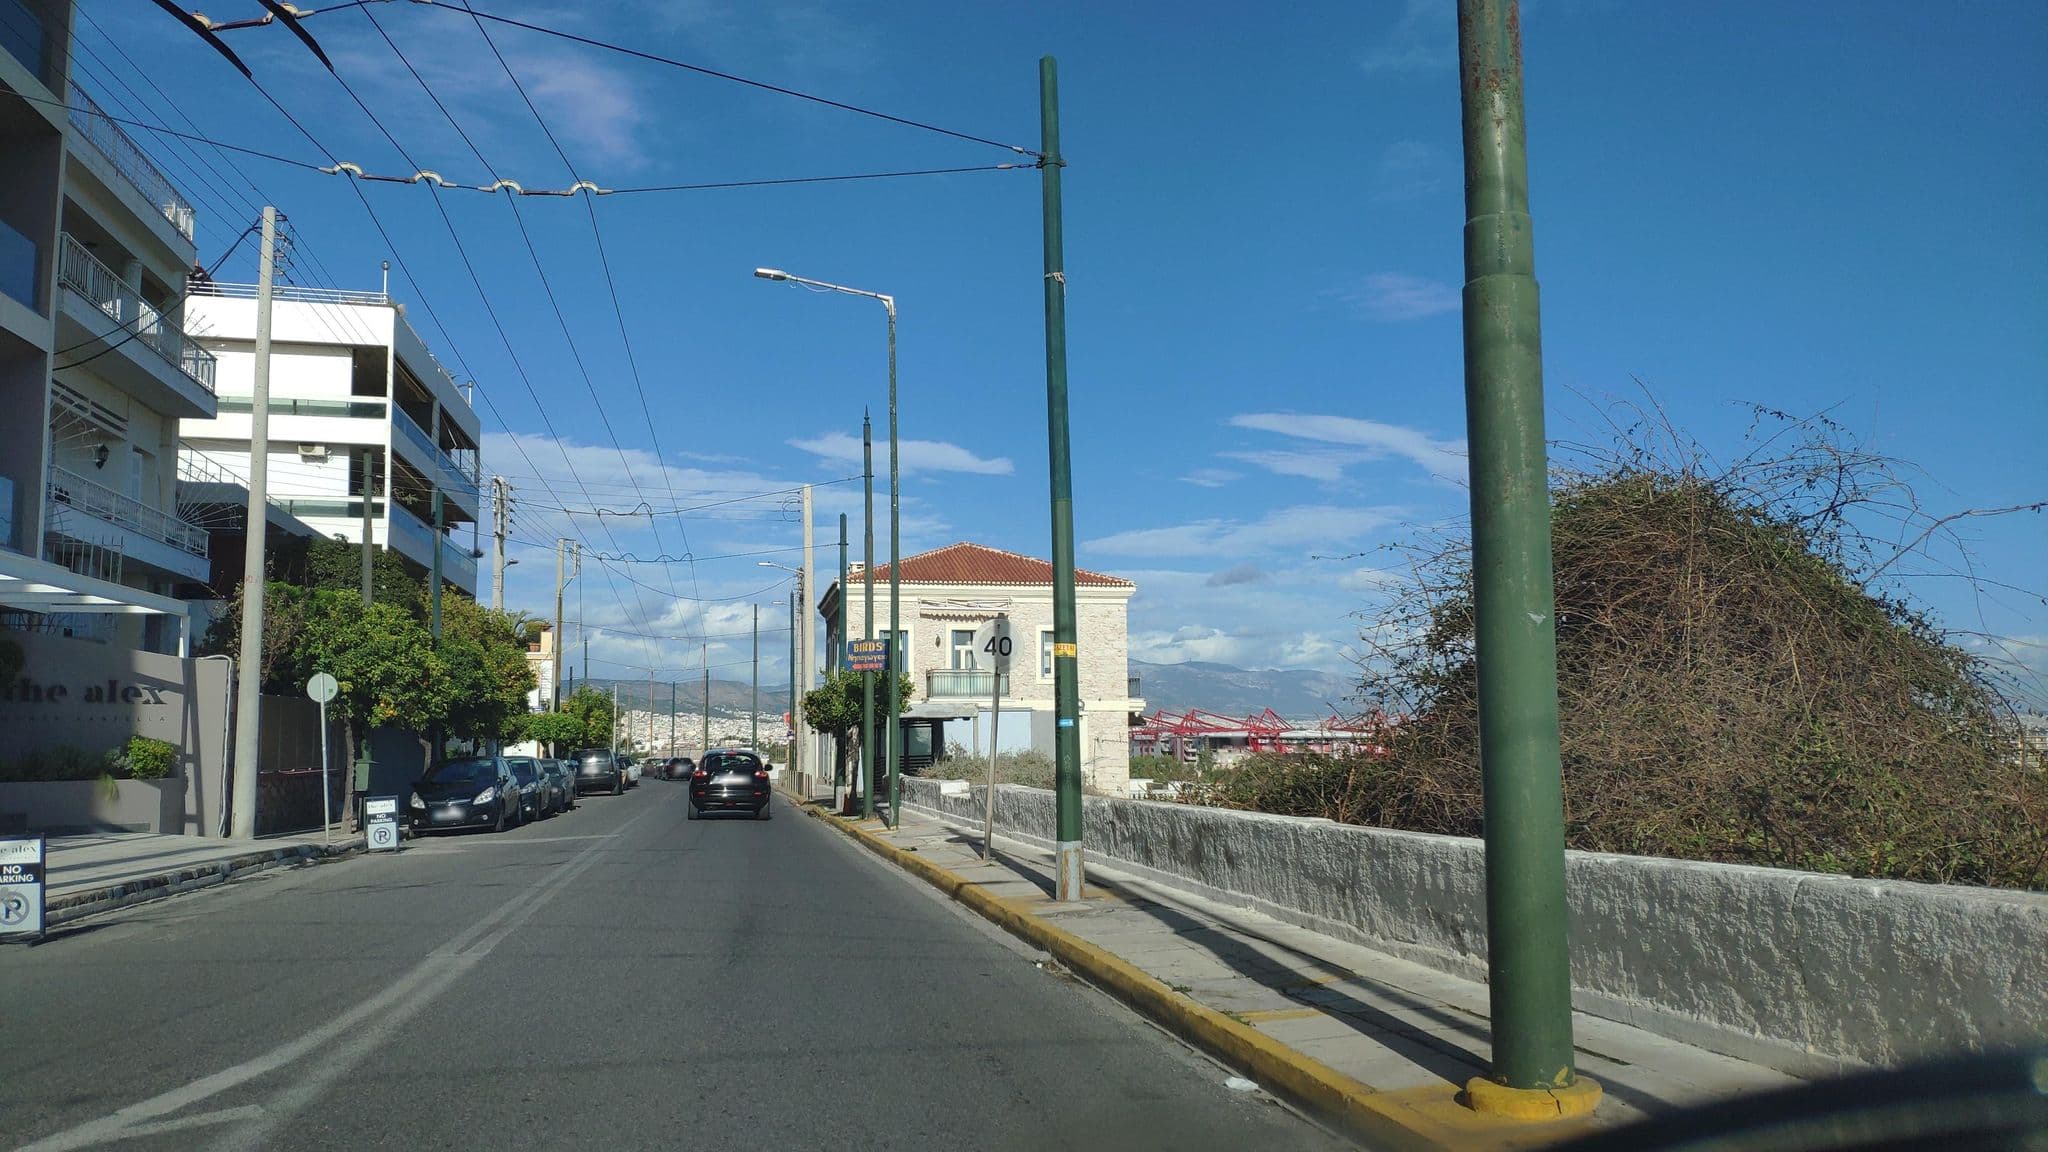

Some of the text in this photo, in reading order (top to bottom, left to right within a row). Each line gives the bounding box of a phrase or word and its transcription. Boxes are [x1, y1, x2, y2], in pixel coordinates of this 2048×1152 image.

[854, 642, 883, 652] BIRDS
[984, 636, 1012, 656] 40
[83, 679, 167, 704] alex
[3, 865, 22, 874] NO
[0, 874, 34, 883] ARKING
